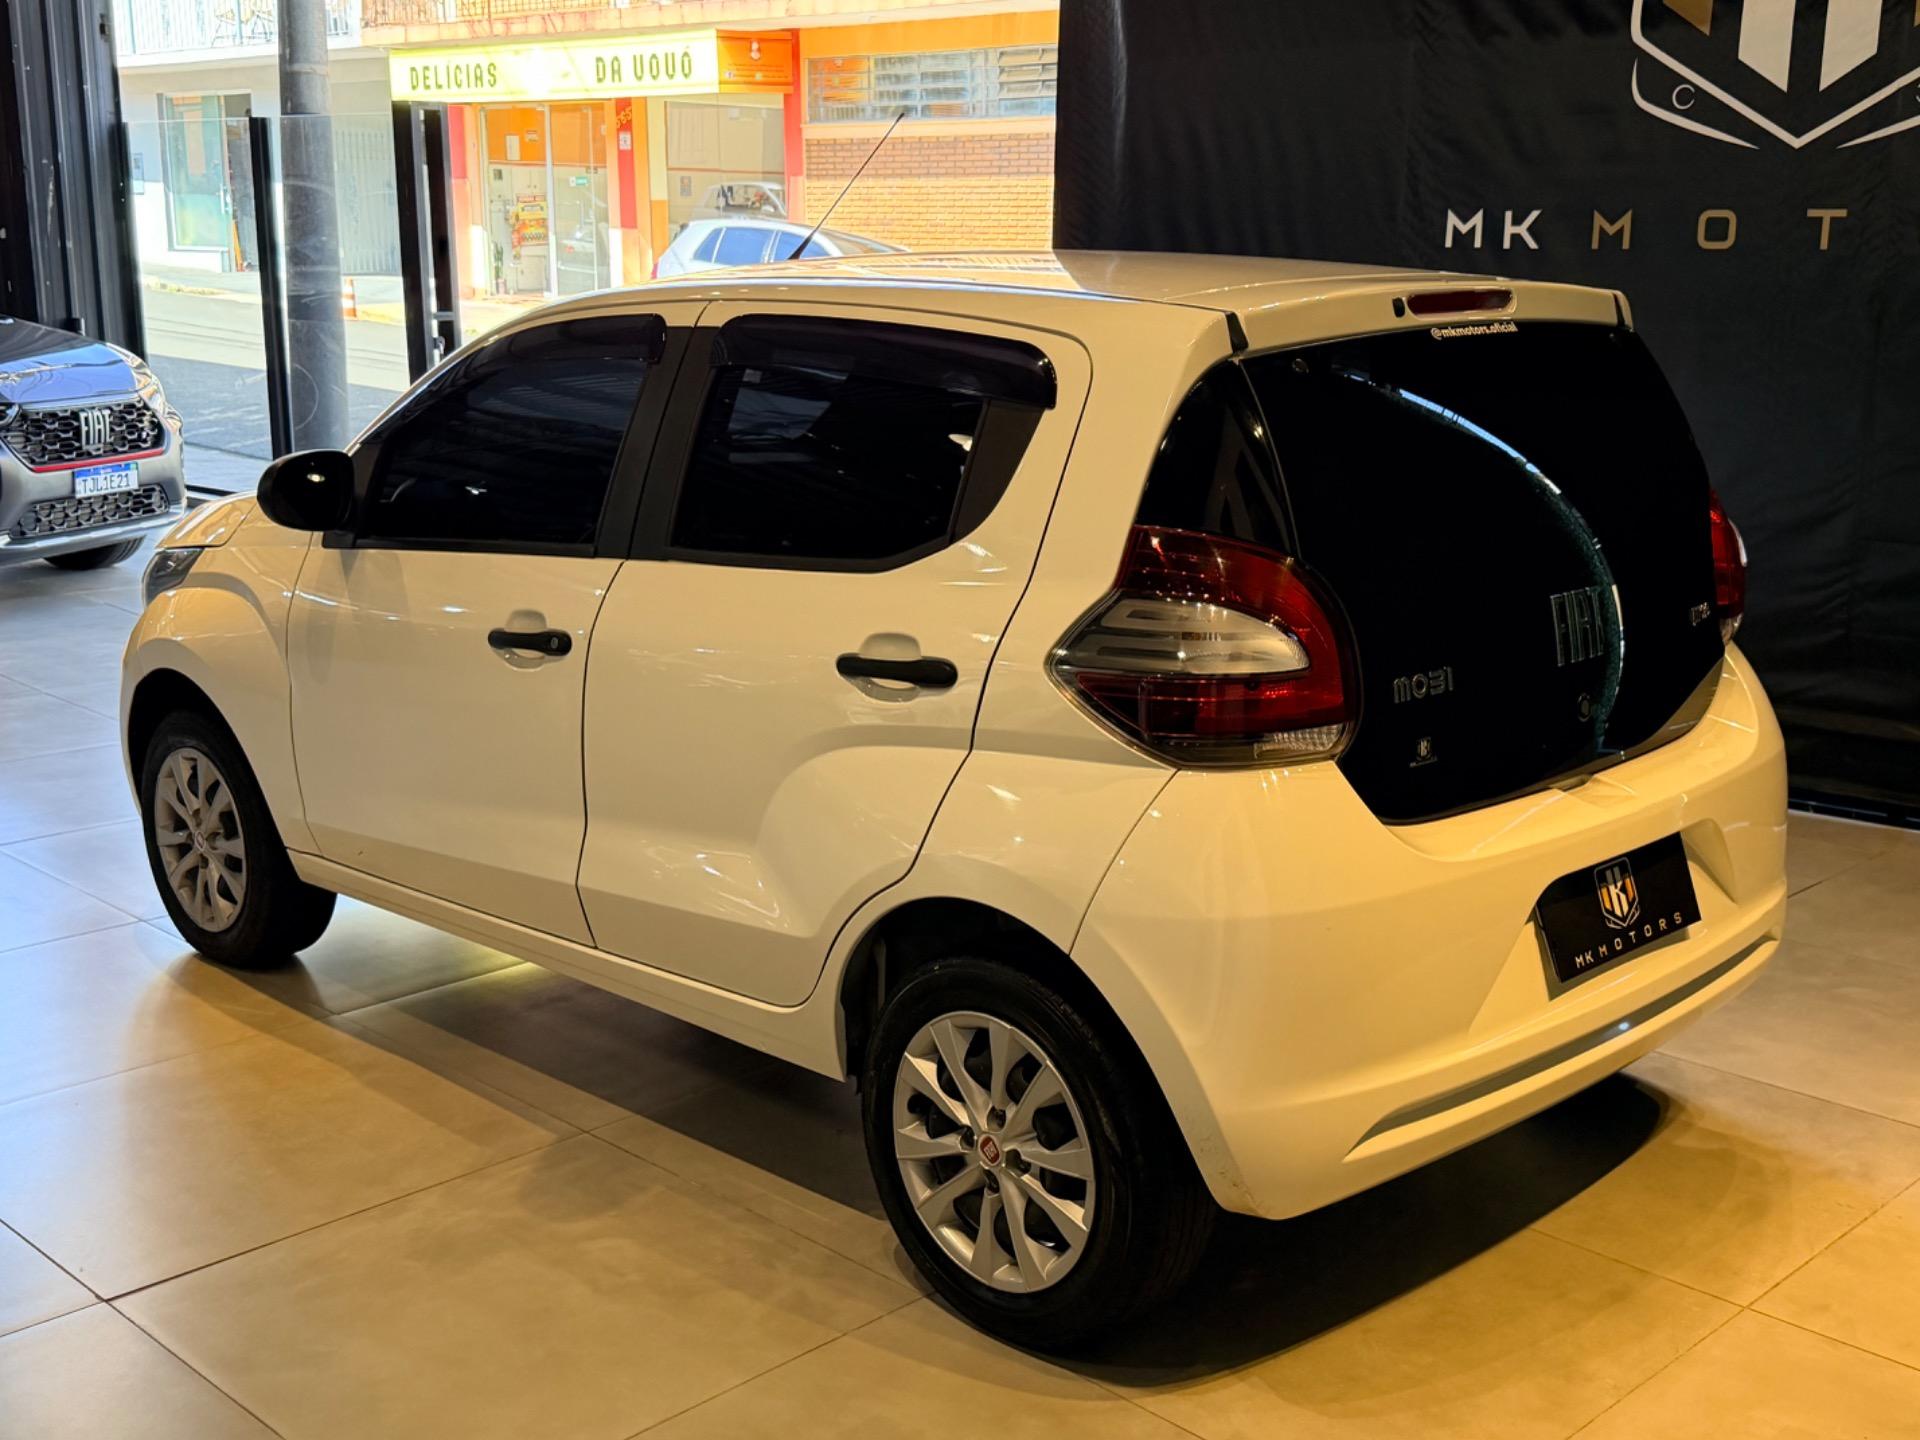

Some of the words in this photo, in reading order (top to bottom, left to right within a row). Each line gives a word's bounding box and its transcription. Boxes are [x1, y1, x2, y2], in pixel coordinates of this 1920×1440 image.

[595, 56, 622, 83] DA
[79, 408, 114, 449] FIAT
[82, 473, 130, 494] TJL1E21
